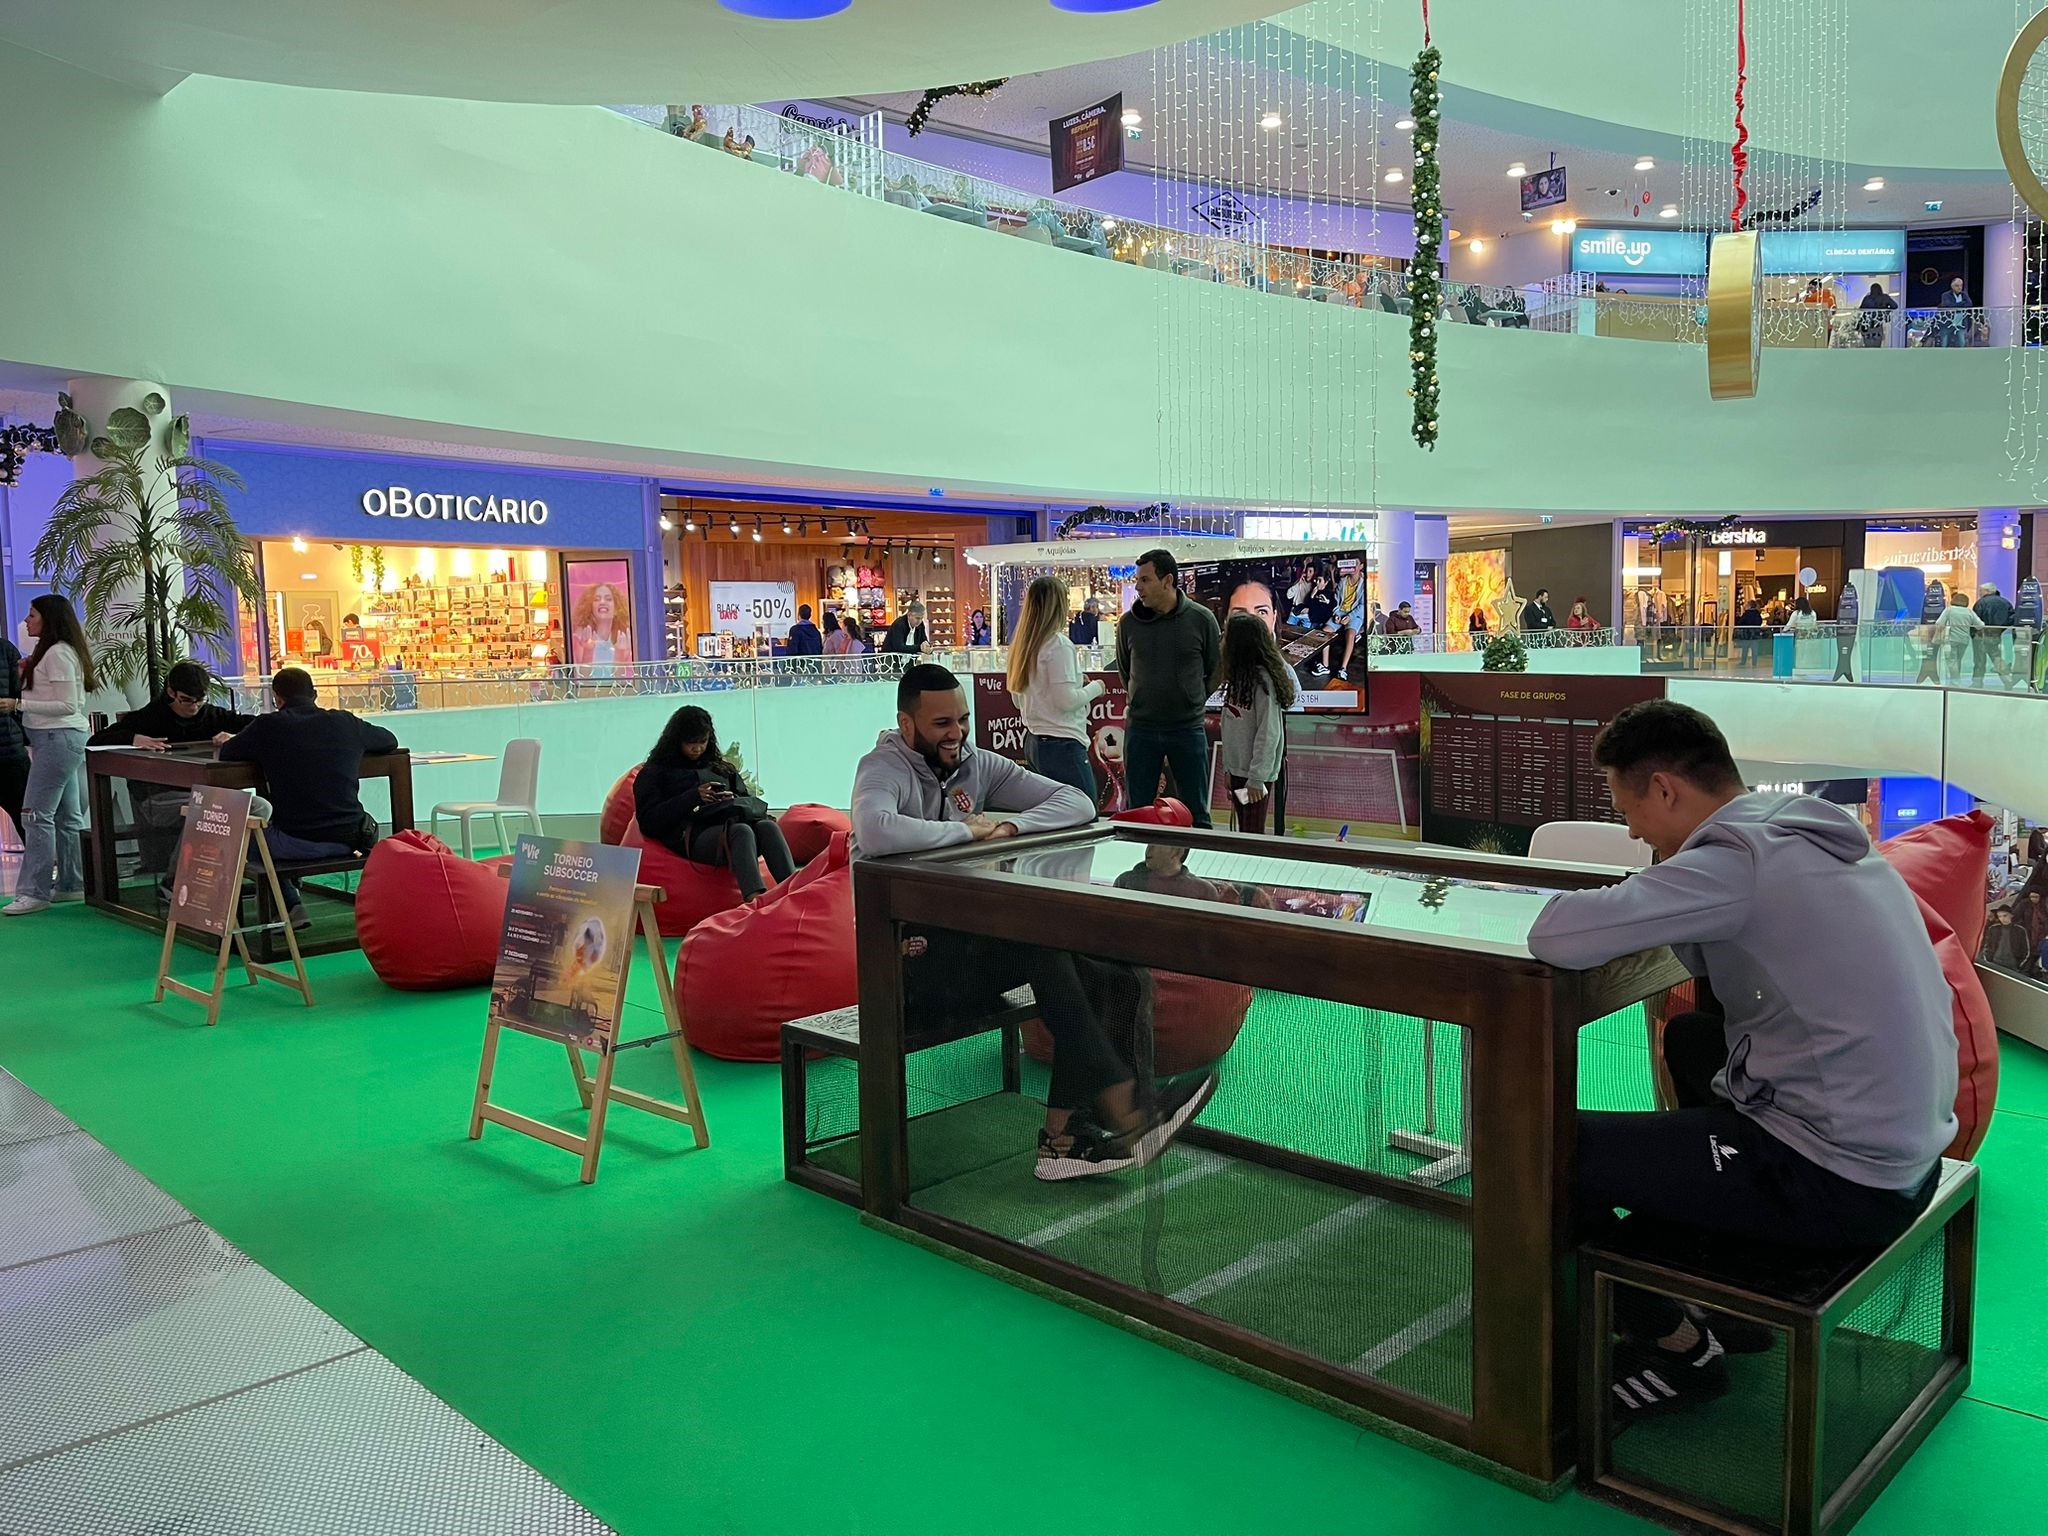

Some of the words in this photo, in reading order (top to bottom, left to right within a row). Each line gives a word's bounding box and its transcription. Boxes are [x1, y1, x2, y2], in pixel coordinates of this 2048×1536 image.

[1580, 237, 1652, 256] smile.up
[717, 603, 740, 613] BLACK
[745, 598, 792, 620] -50%
[720, 610, 738, 620] DAYS
[1500, 690, 1520, 699] FASE
[1521, 691, 1531, 699] DE
[1532, 692, 1566, 701] GRUPOS
[988, 716, 1022, 731] MATCH
[993, 728, 1028, 750] DAY
[203, 810, 229, 823] TORNEIO
[196, 821, 231, 836] SUBSOCCER
[553, 853, 593, 868] TORNEIO
[543, 864, 599, 883] SUBSOCCER
[1709, 1135, 1722, 1171] Lacatoni
